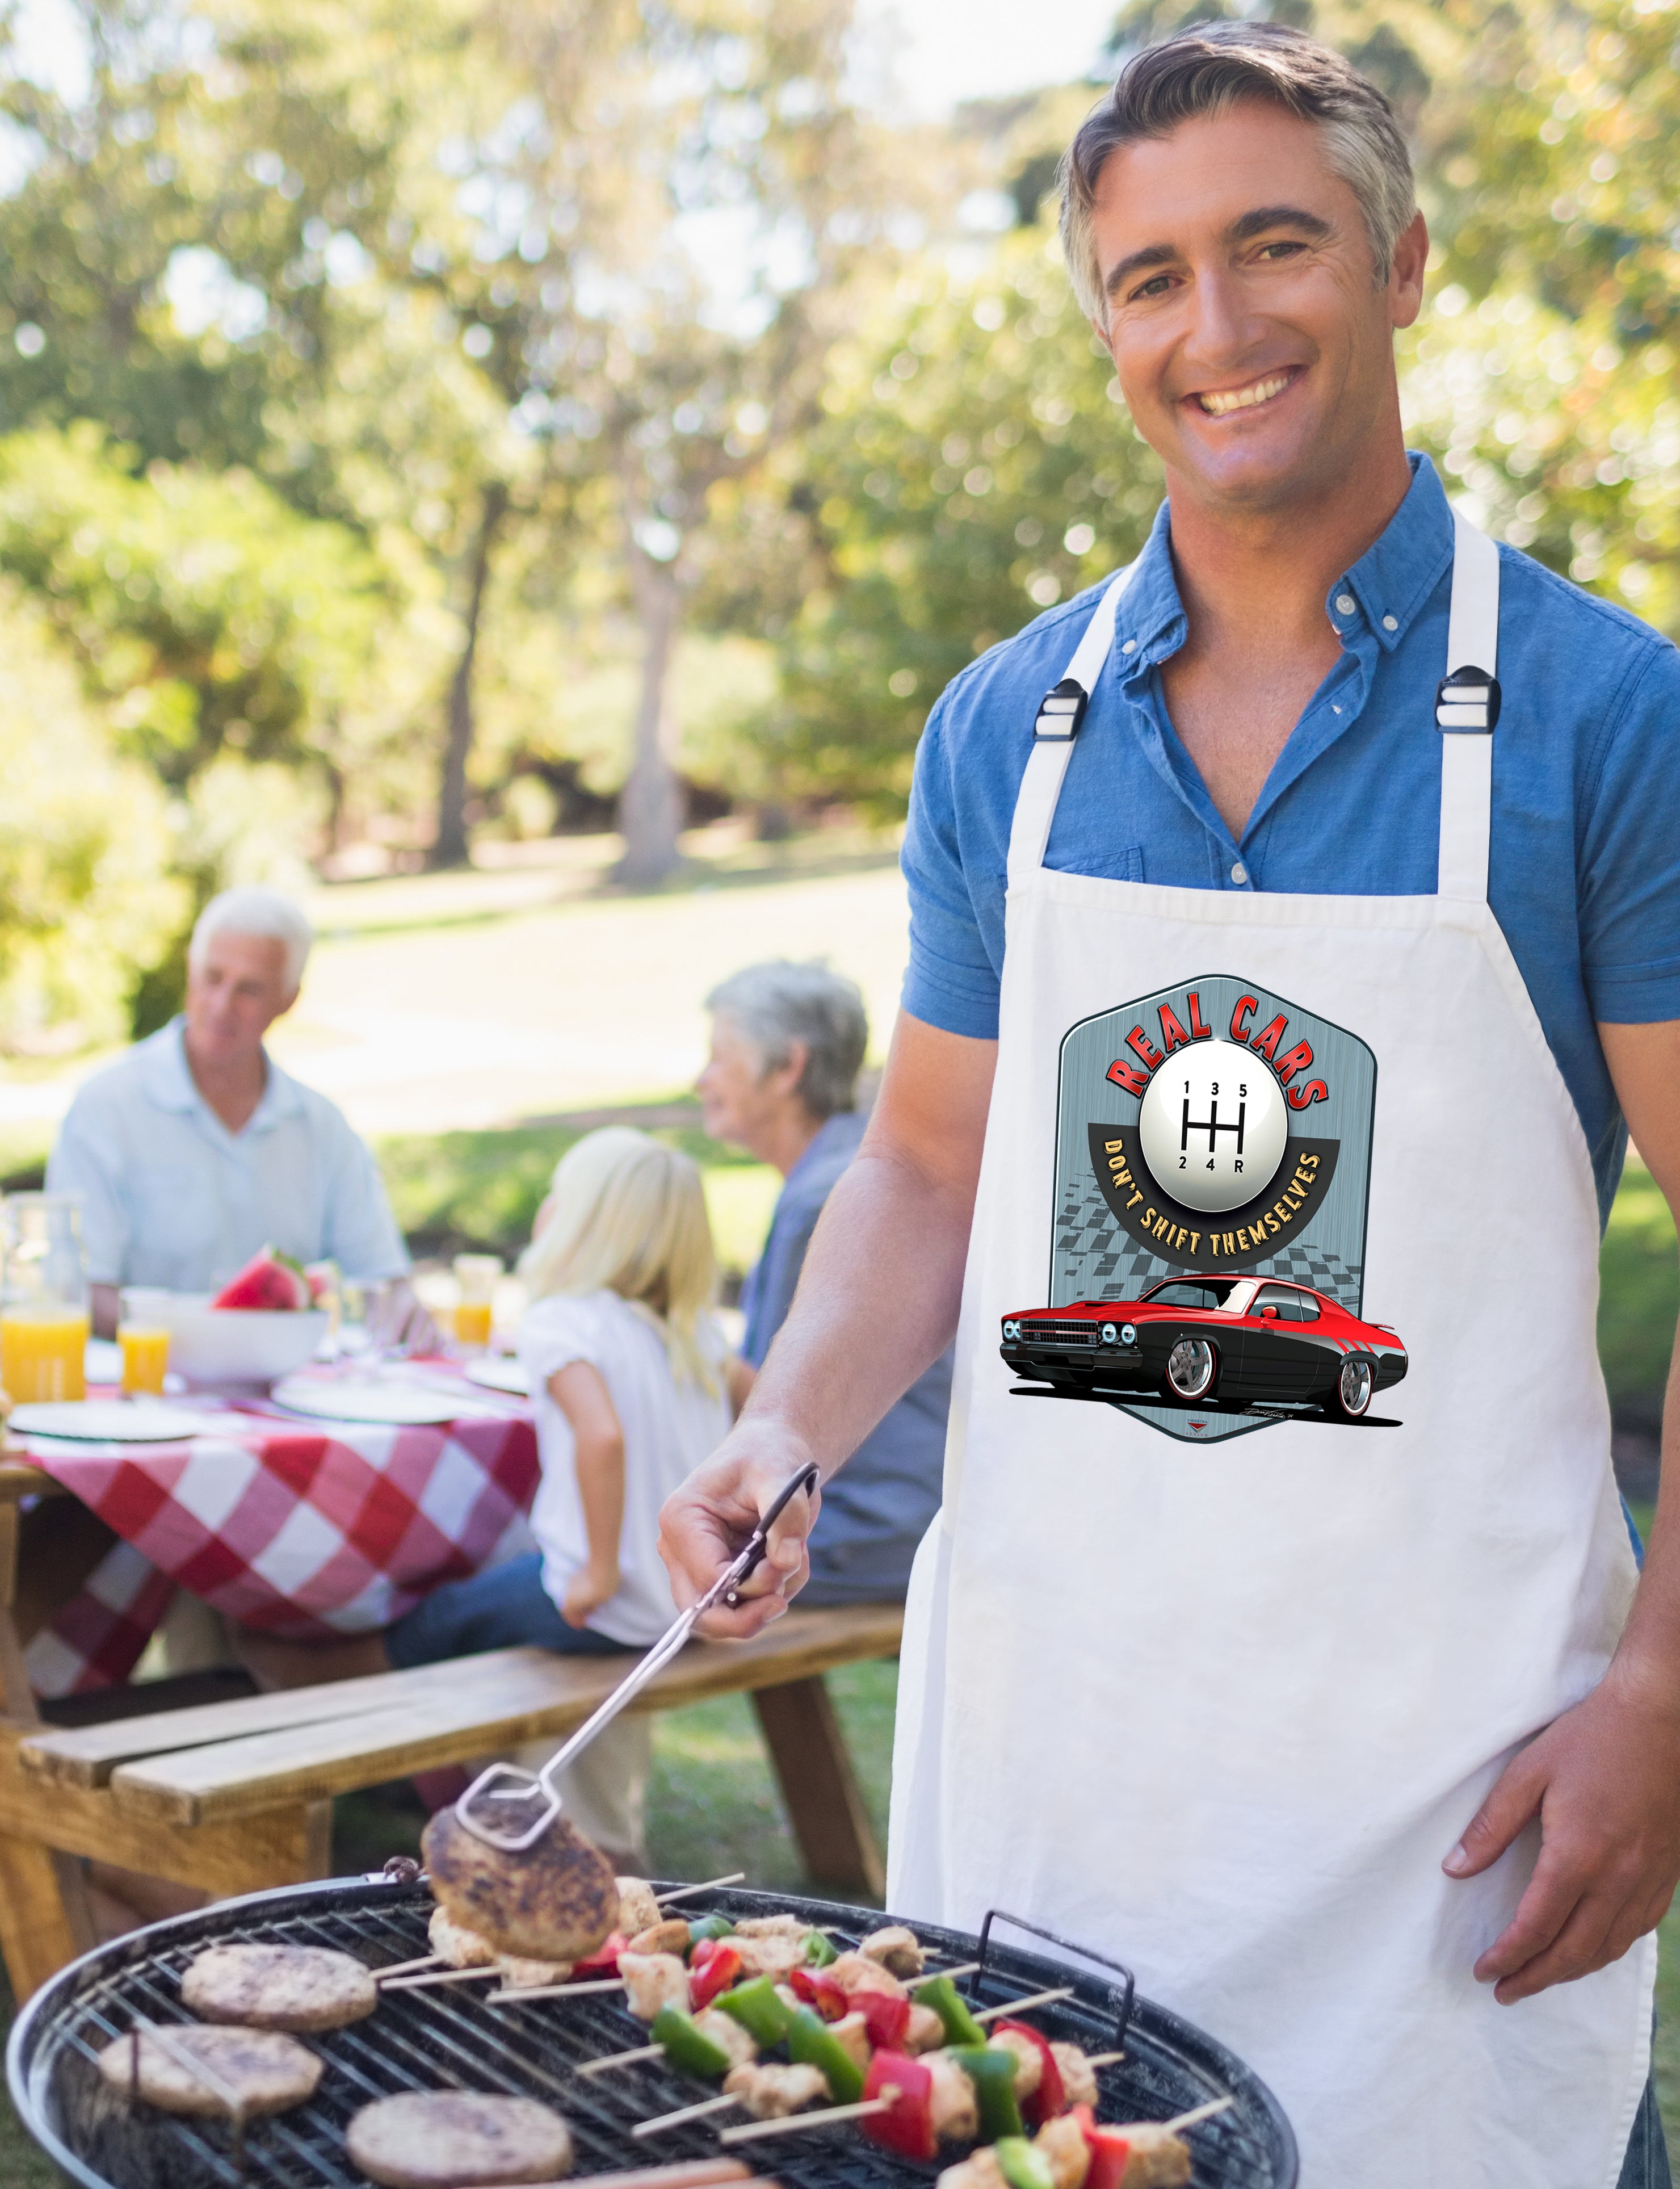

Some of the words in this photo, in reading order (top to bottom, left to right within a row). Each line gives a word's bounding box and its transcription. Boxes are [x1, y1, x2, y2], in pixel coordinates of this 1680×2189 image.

[1106, 992, 1211, 1098] REAL
[1229, 995, 1329, 1110] CARS
[1185, 1080, 1189, 1093] 1
[1211, 1082, 1219, 1096] 3
[1239, 1084, 1248, 1097] 5
[1104, 1139, 1144, 1210] DON'T
[1140, 1207, 1202, 1255] SHIFT
[1209, 1152, 1321, 1257] THEMSELVES
[1179, 1156, 1187, 1169] 2
[1206, 1158, 1215, 1171] 4
[1234, 1159, 1244, 1173] R
